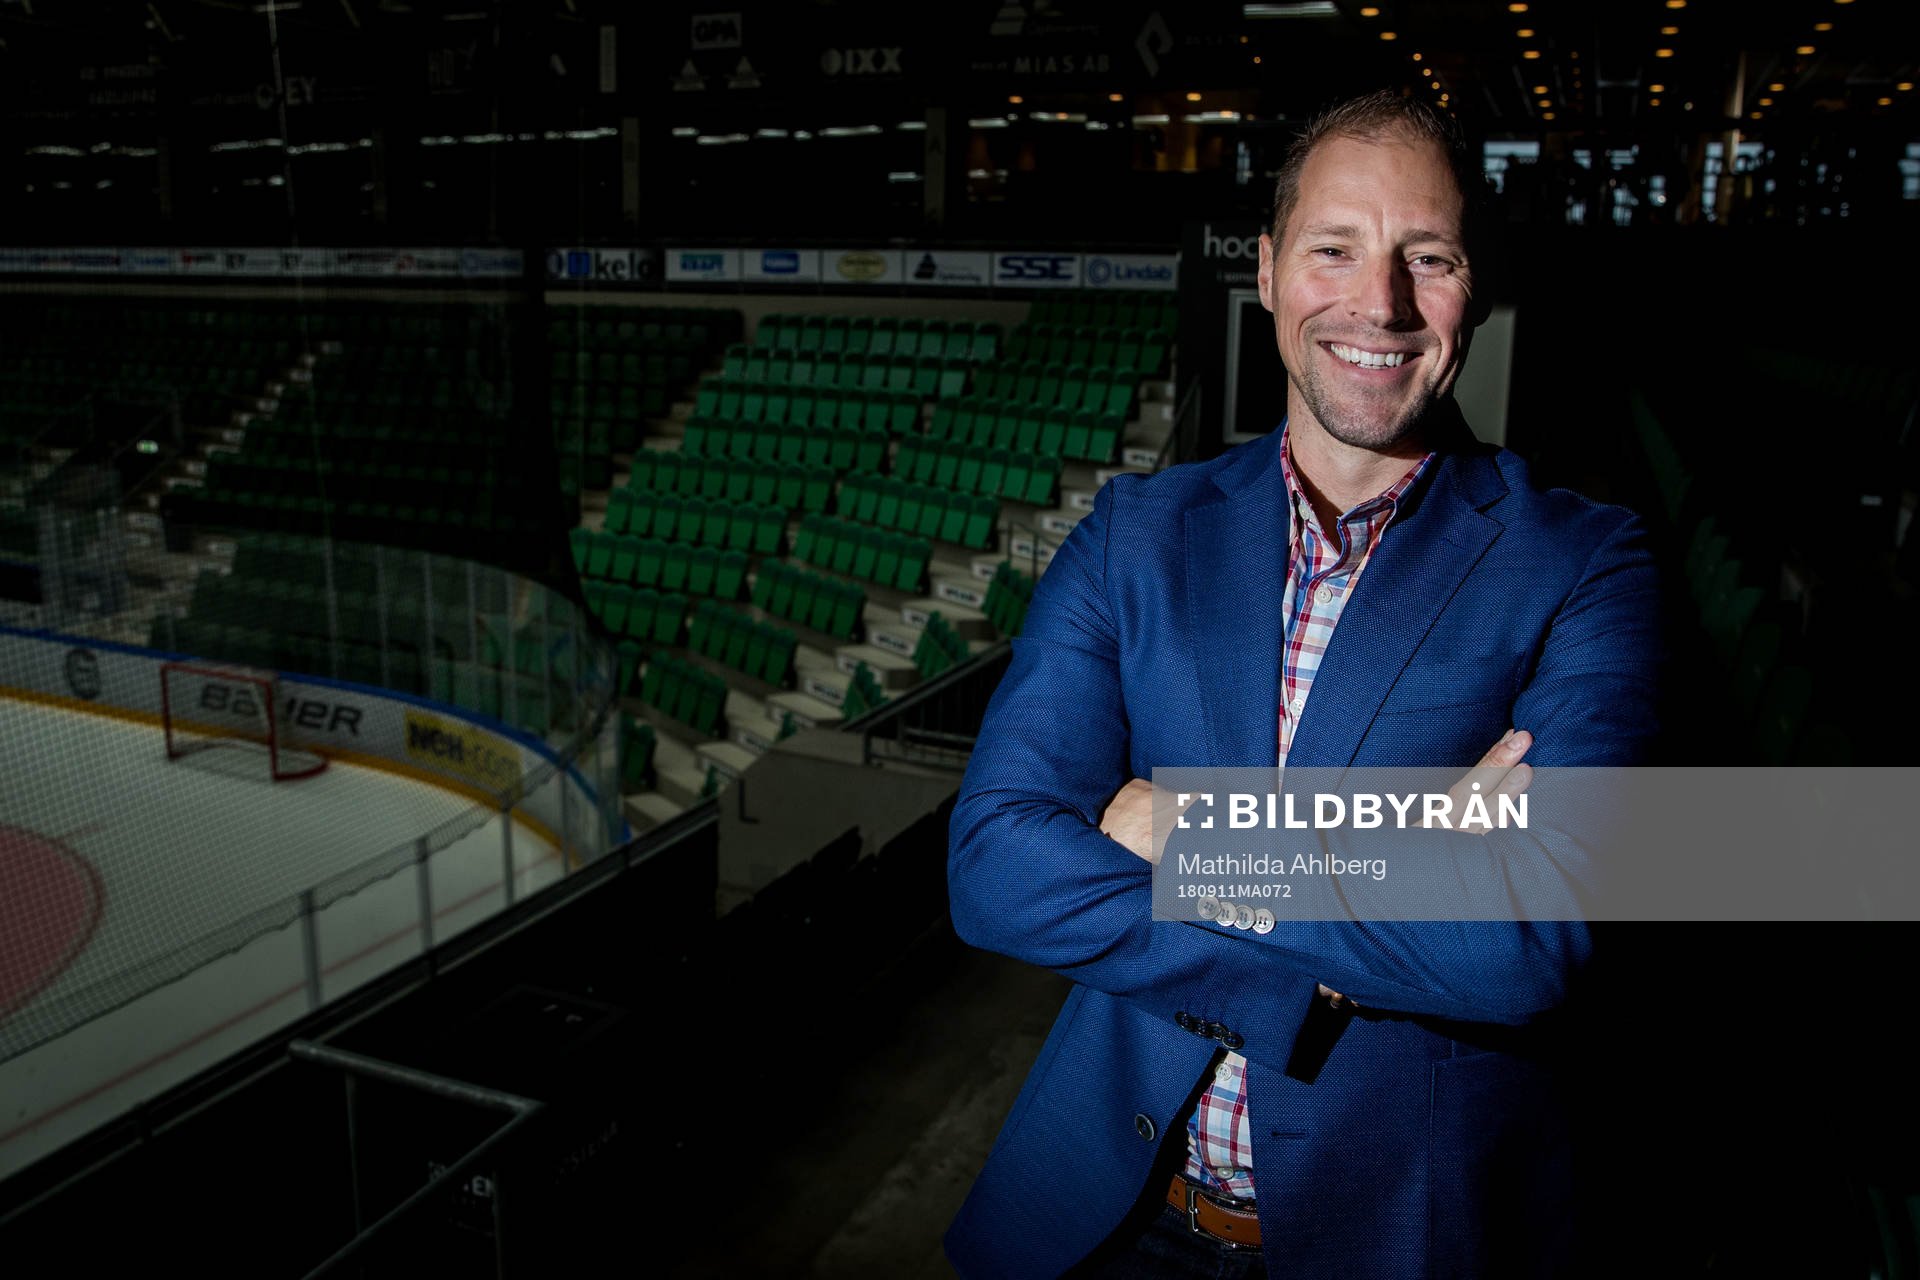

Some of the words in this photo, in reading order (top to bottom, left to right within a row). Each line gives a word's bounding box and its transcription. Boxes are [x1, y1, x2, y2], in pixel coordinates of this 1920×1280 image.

[1203, 223, 1268, 259] hoc
[998, 256, 1075, 280] SSE
[1115, 263, 1173, 281] Lindab
